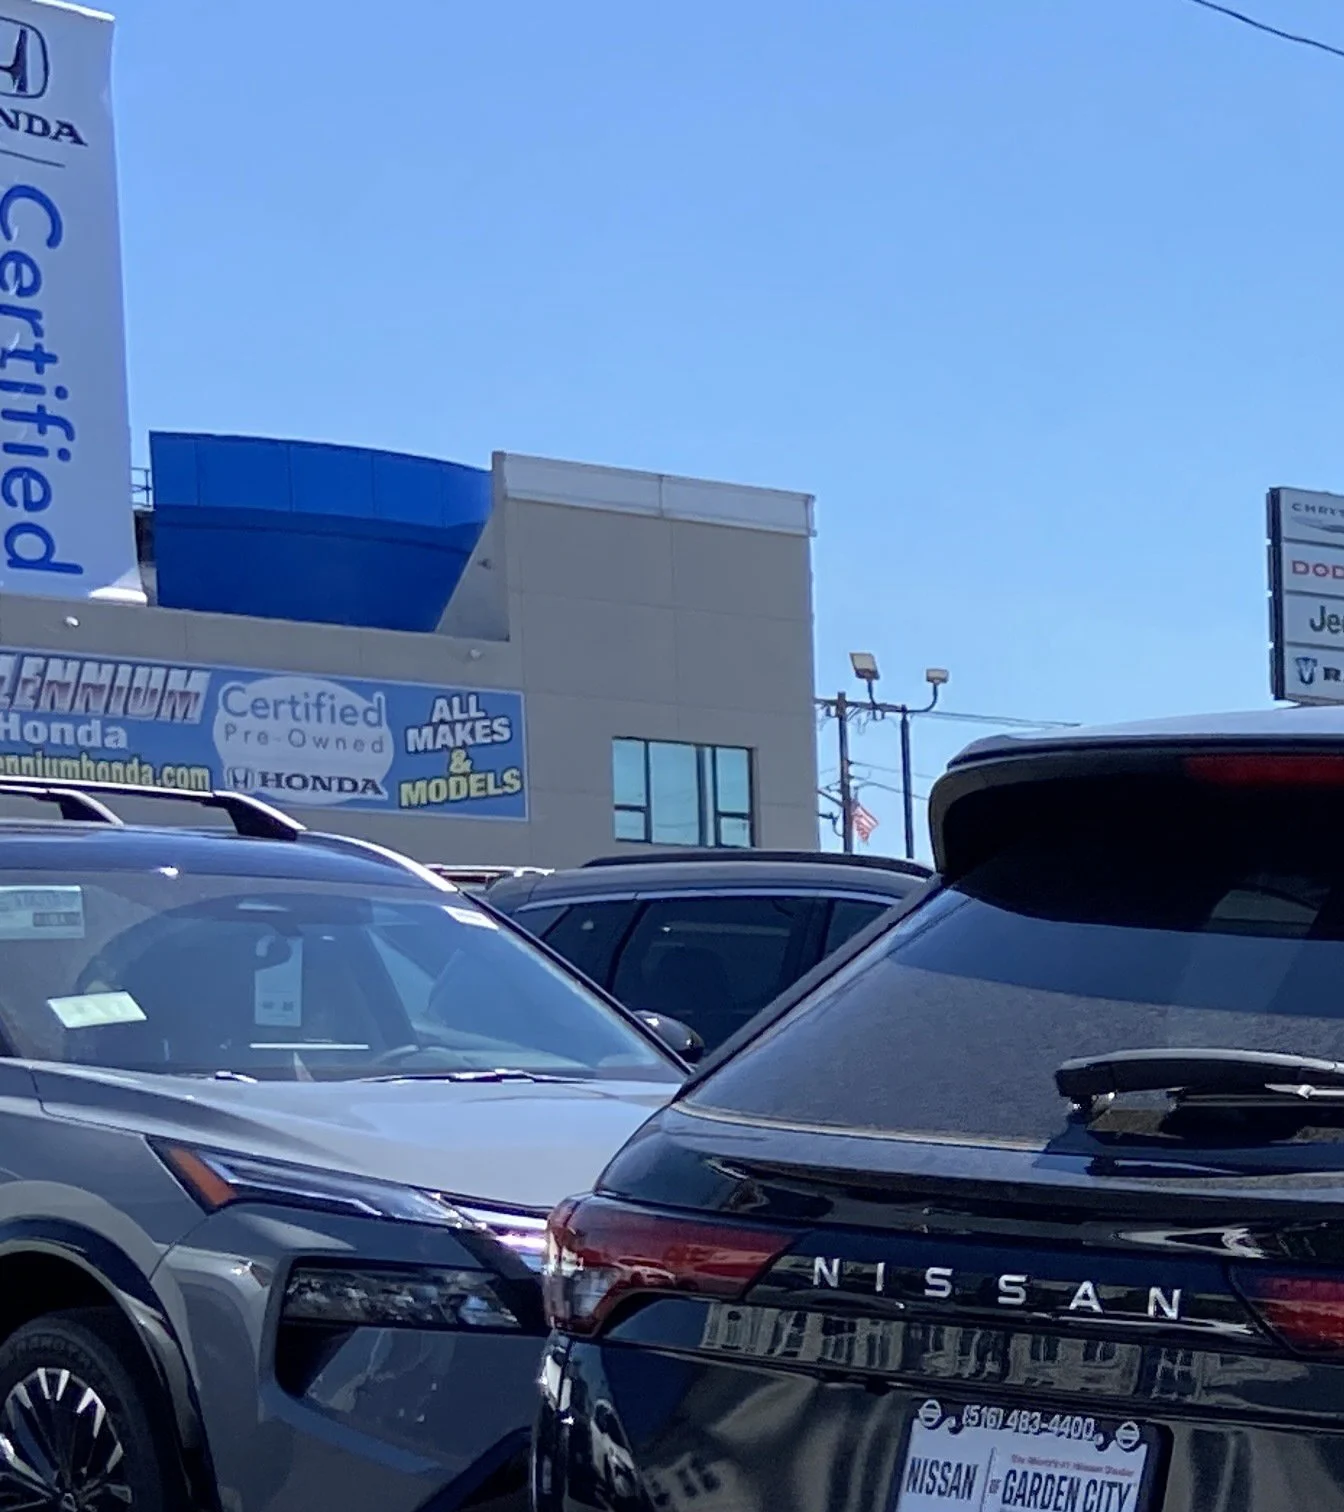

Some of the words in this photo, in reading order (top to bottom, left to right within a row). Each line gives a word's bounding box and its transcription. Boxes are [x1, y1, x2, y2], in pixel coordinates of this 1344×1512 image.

[0, 183, 84, 575] Certified
[221, 684, 384, 728] Certified
[430, 692, 488, 723] ALL
[0, 711, 128, 750] Honda
[224, 723, 385, 754] Pre-Owned
[405, 716, 513, 753] MAKES
[448, 747, 474, 773] &
[259, 771, 386, 796] HONDA
[399, 766, 523, 808] MODELS
[812, 1256, 1183, 1321] NISSAN
[962, 1404, 1004, 1429] (516)
[1005, 1409, 1095, 1441] 483-4400
[905, 1456, 979, 1501] NISSAN
